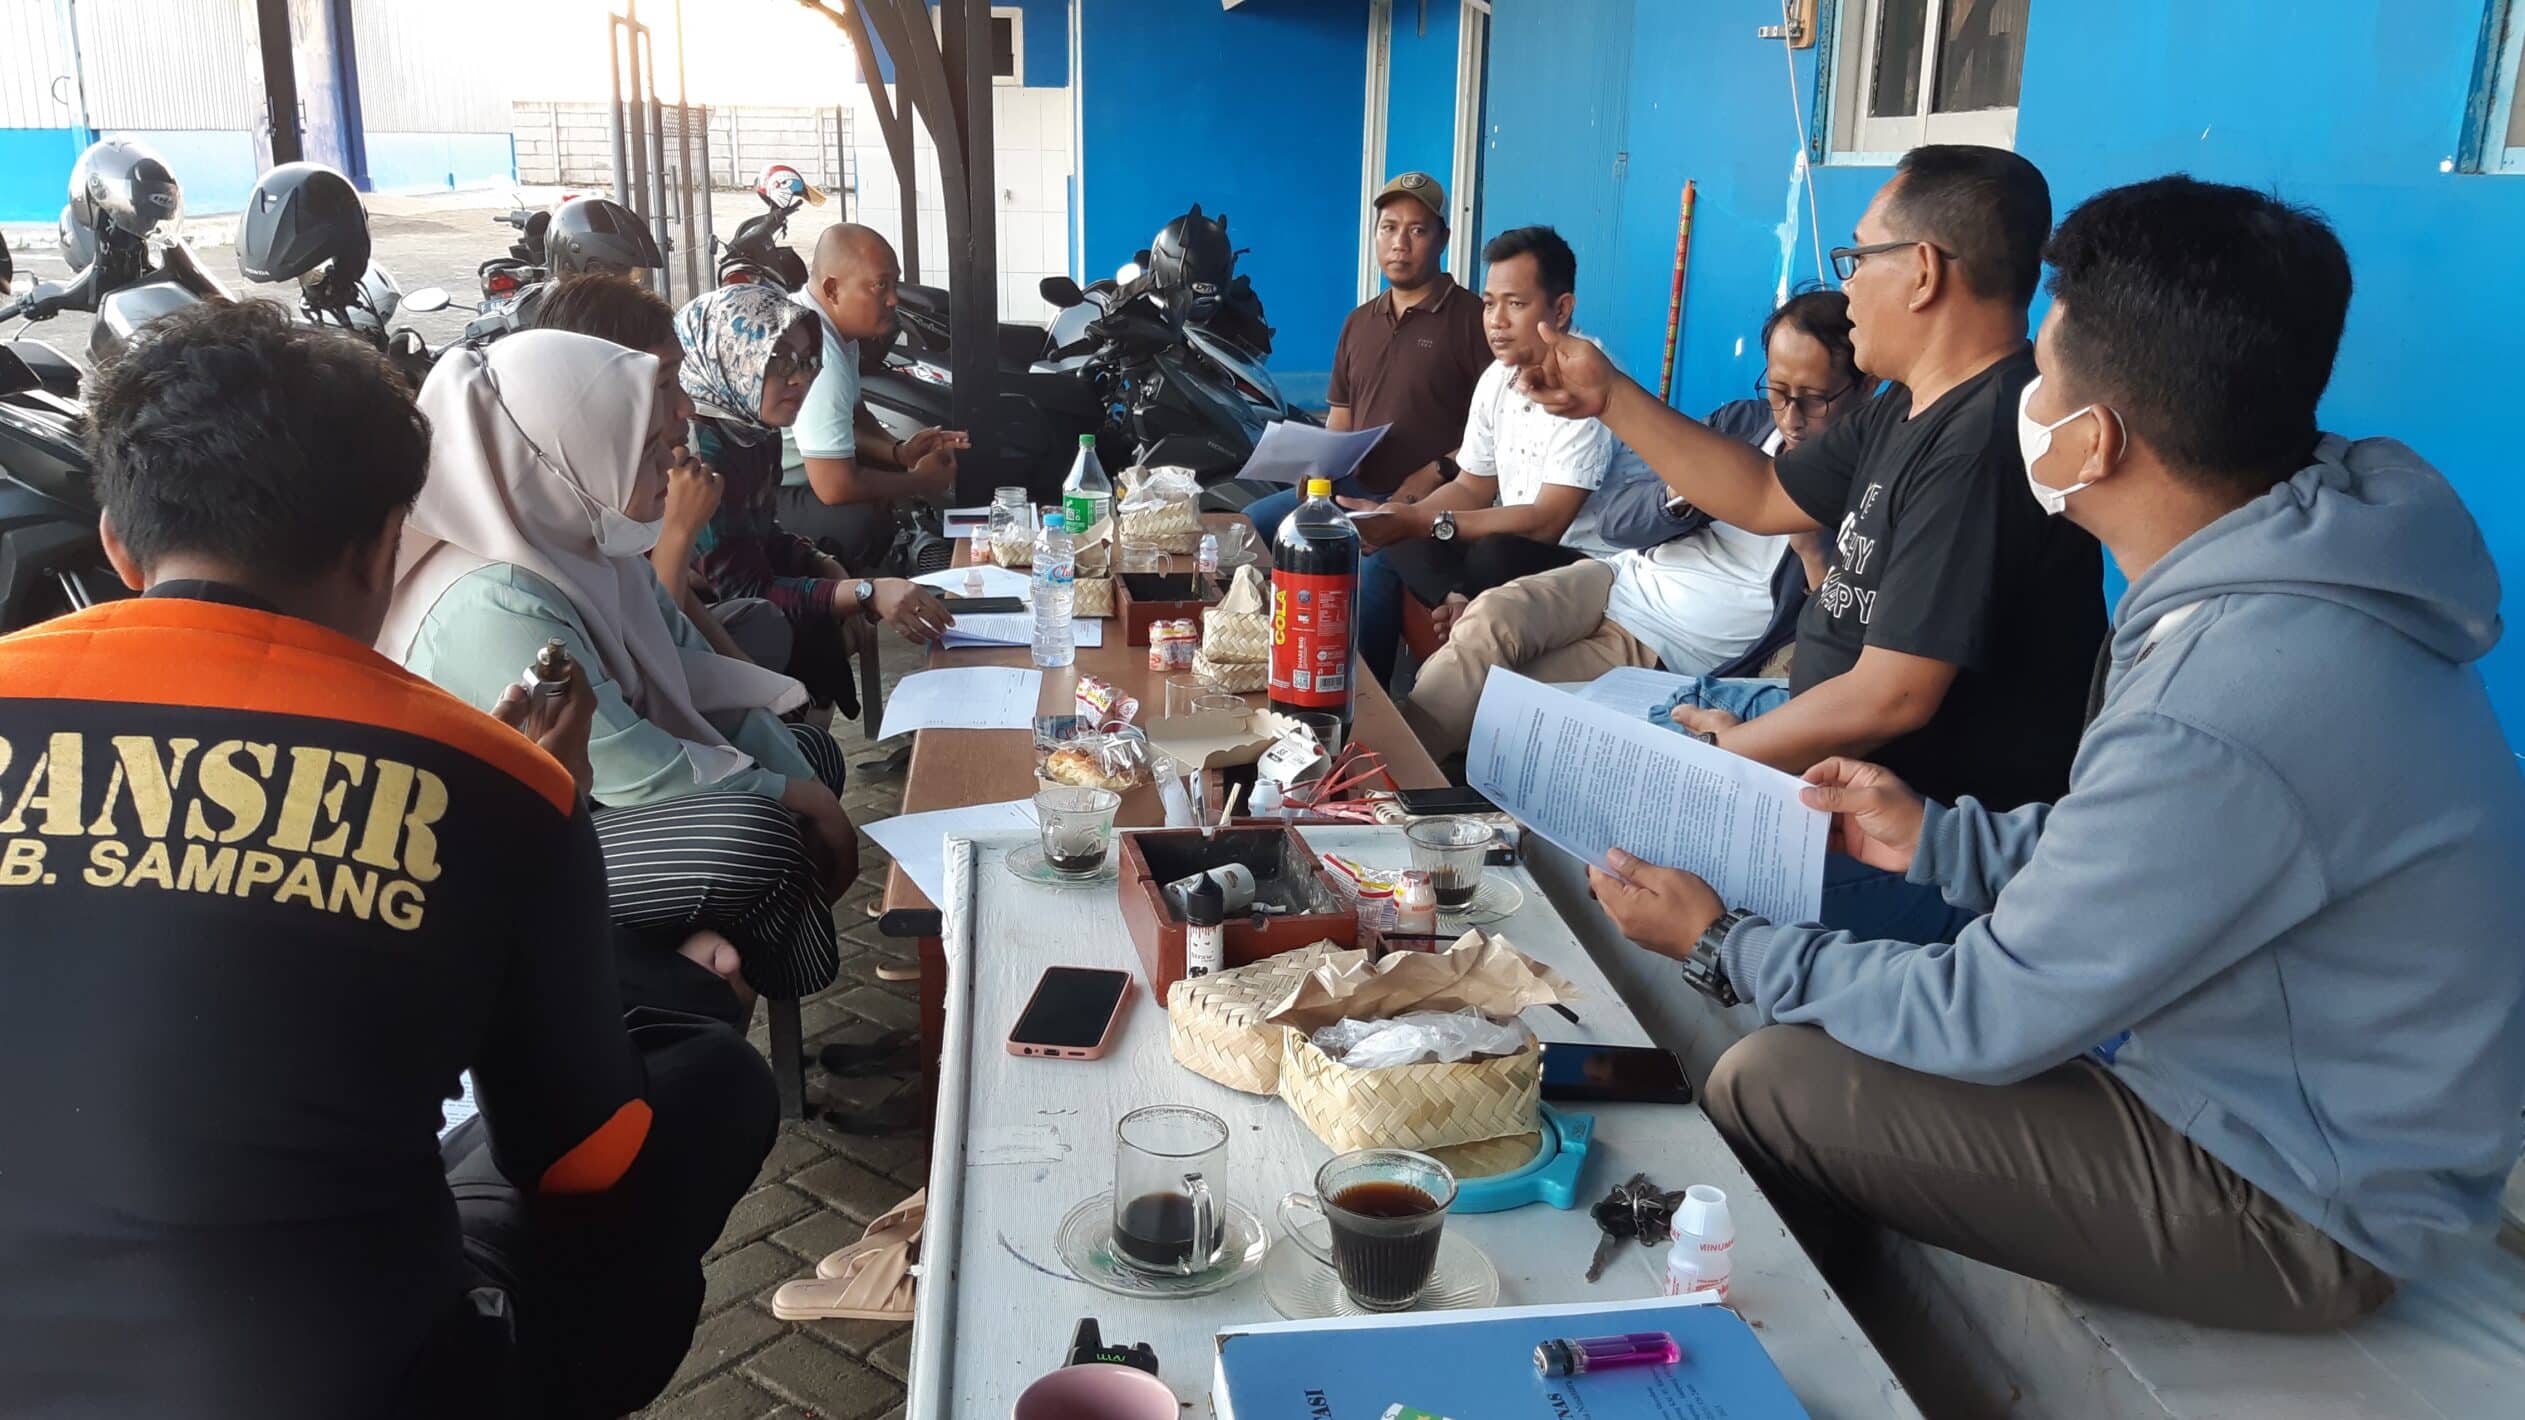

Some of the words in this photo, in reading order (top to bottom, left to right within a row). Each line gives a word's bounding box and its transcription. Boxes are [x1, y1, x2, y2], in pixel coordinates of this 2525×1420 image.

[1274, 589, 1287, 646] COLA
[82, 838, 425, 931] SAMPANG
[1304, 1389, 1333, 1420] ASI
[1546, 1392, 1574, 1420] NAS
